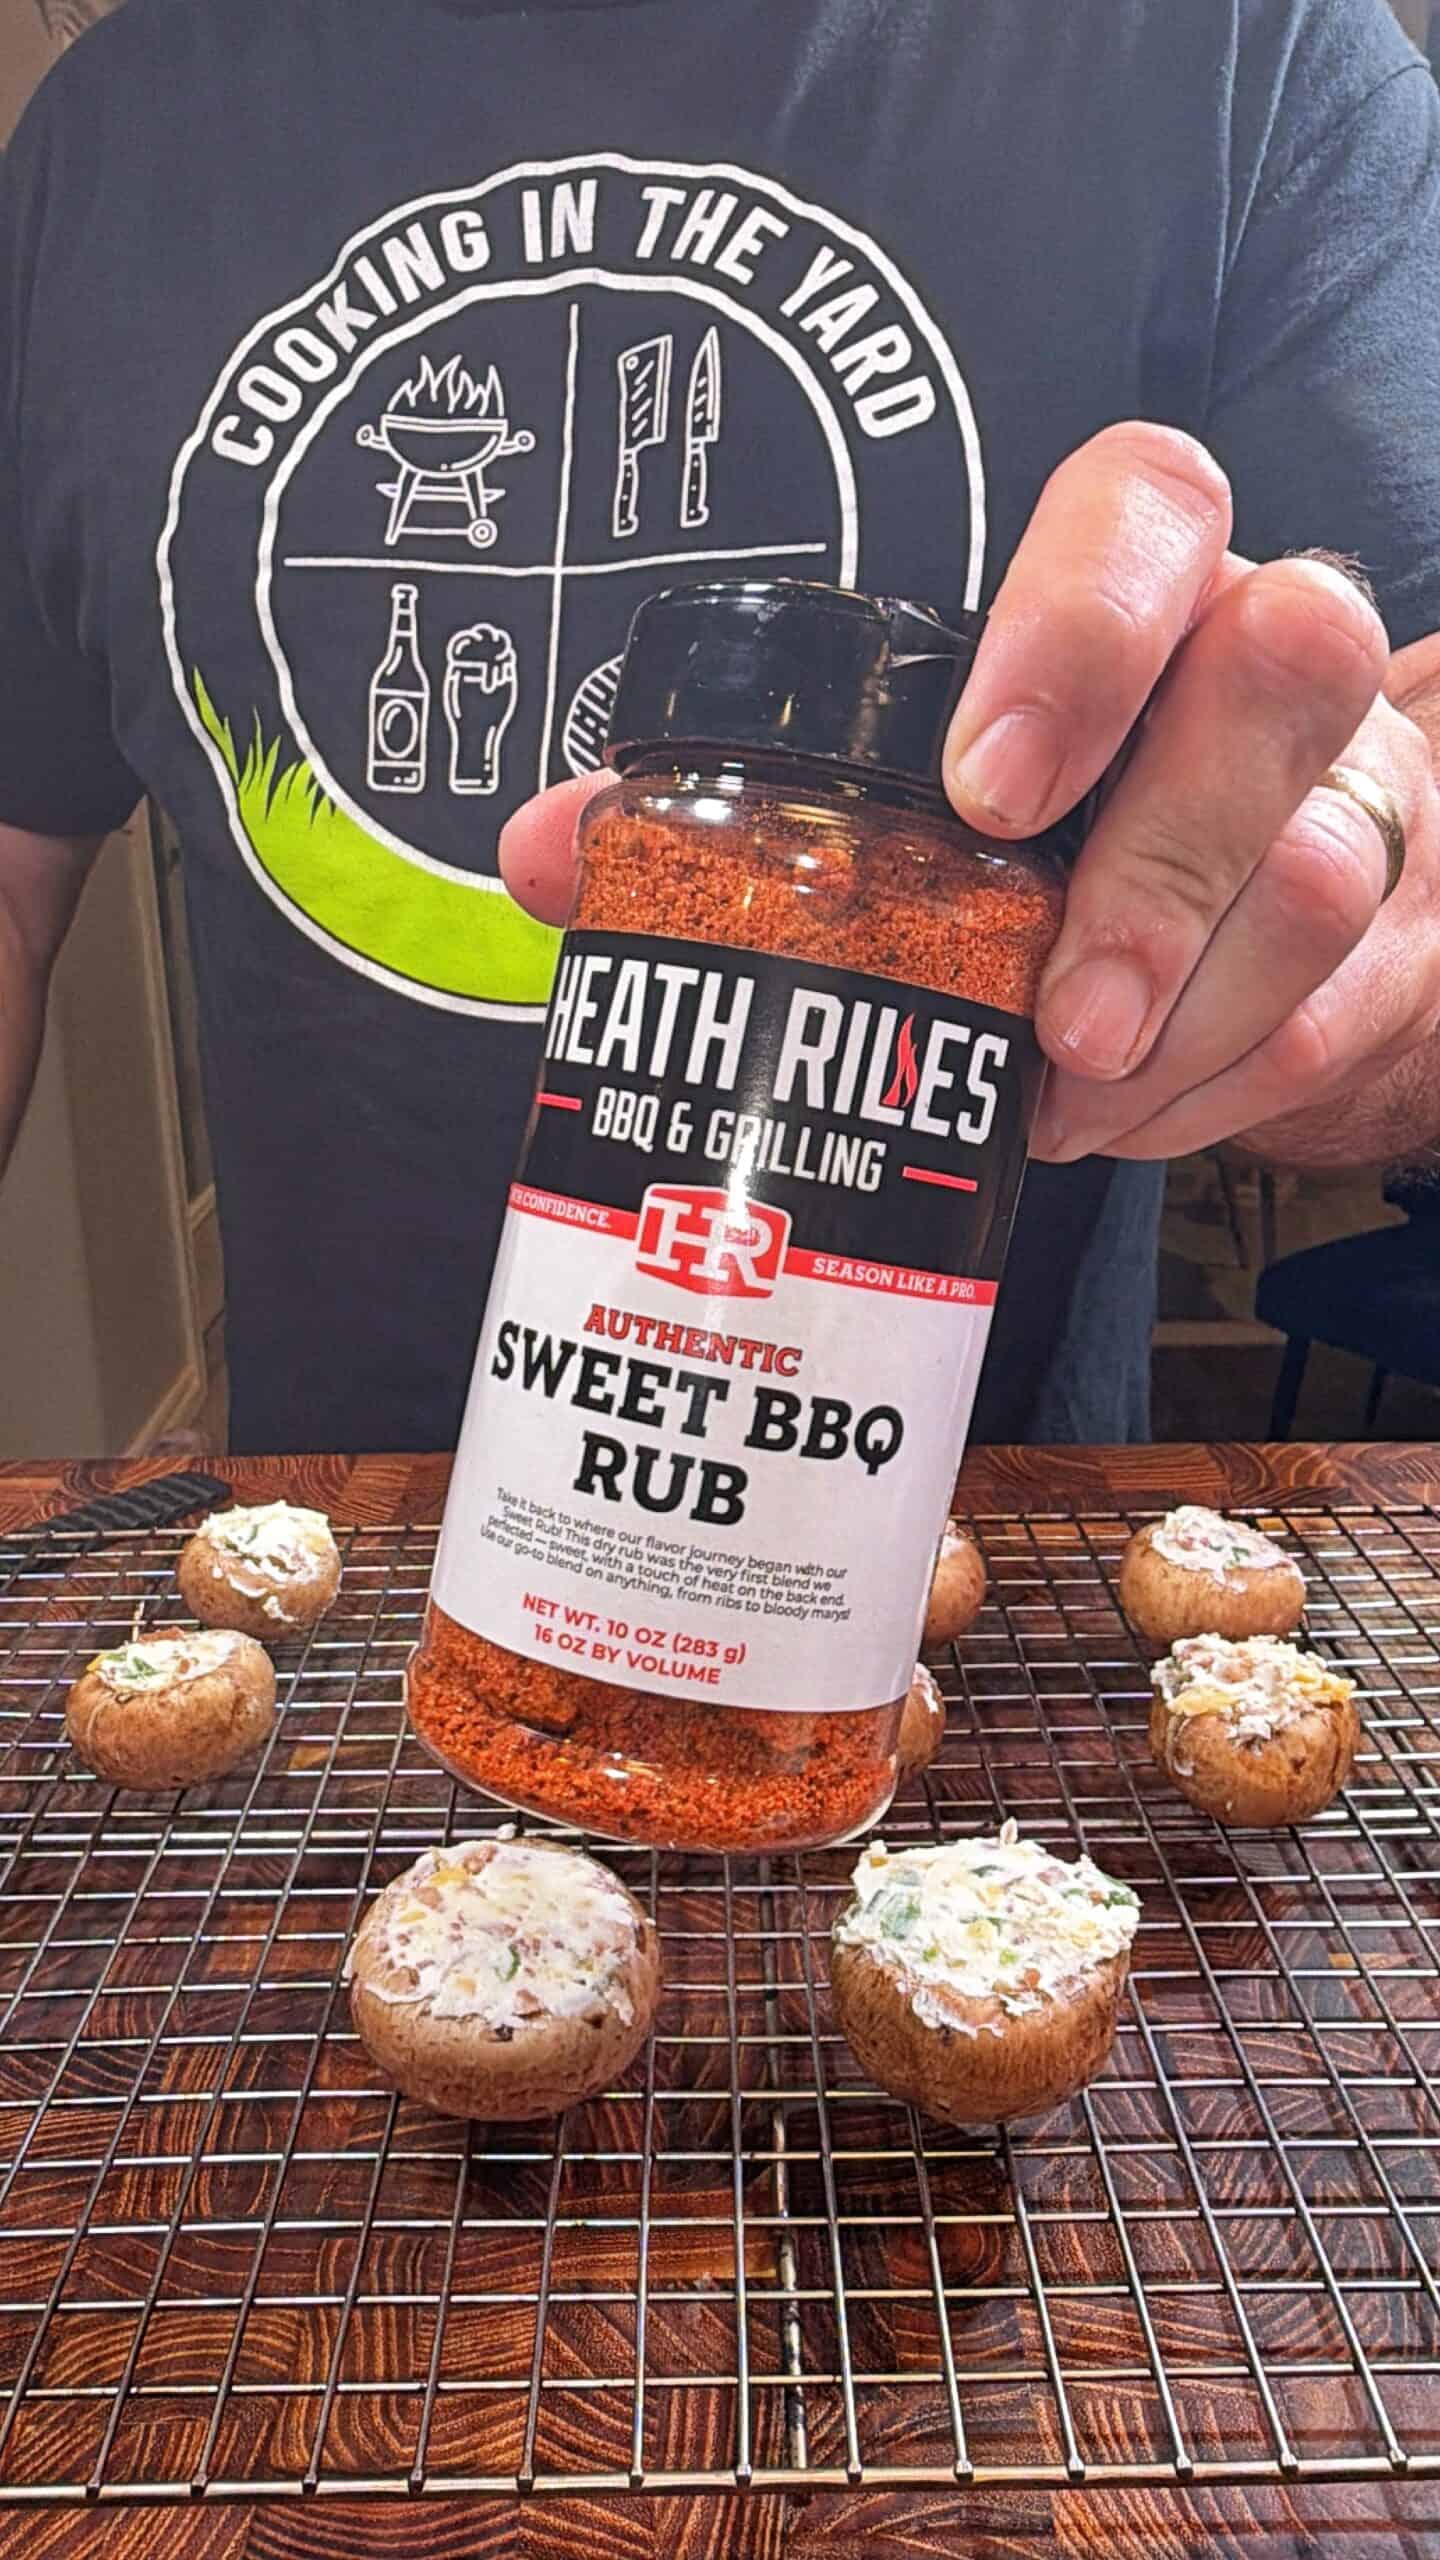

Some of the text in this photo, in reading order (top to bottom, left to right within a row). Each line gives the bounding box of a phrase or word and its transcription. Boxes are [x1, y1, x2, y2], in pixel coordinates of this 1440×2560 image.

[211, 180, 938, 467] COOKING IN THE YARD
[545, 955, 1010, 1145] HEATH RILES
[592, 1087, 887, 1192] BBQ & GRILLING
[812, 1257, 895, 1286] SEASON
[897, 1273, 935, 1294] LIKE
[937, 1282, 948, 1296] A
[583, 1302, 804, 1378] AUTHENTIC
[491, 1319, 904, 1476] SWEET BBQ
[573, 1429, 749, 1526] RUB
[480, 1523, 496, 1541] Use
[496, 1534, 514, 1549] our
[514, 1543, 545, 1562] go-to
[546, 1552, 583, 1574] blend
[585, 1564, 603, 1580] on
[605, 1573, 673, 1601] anything,
[676, 1586, 713, 1606] from
[715, 1593, 743, 1610] ribs
[745, 1600, 761, 1613] to
[763, 1600, 809, 1621] bloody
[488, 1514, 534, 1543] perfected
[591, 1552, 623, 1571] with
[625, 1562, 635, 1574] a
[638, 1563, 680, 1583] touch
[683, 1573, 700, 1587] of
[701, 1577, 735, 1595] heat
[737, 1585, 756, 1598] on
[759, 1586, 784, 1602] the
[786, 1590, 817, 1606] back
[497, 1487, 848, 1580] Take it back to where our flavor journey began with our
[503, 1505, 534, 1528] Sweet
[565, 1528, 591, 1547] This
[593, 1537, 616, 1555] dry
[617, 1545, 644, 1562] rub
[646, 1552, 676, 1568] was
[679, 1556, 705, 1573] the
[706, 1564, 738, 1581] very
[740, 1568, 768, 1584] first
[771, 1574, 810, 1591] blend
[812, 1580, 832, 1592] we
[522, 1591, 748, 1666] NET WT. 10 OZ (283 g)
[534, 1623, 723, 1685] 16 OZ BY VOLUME
